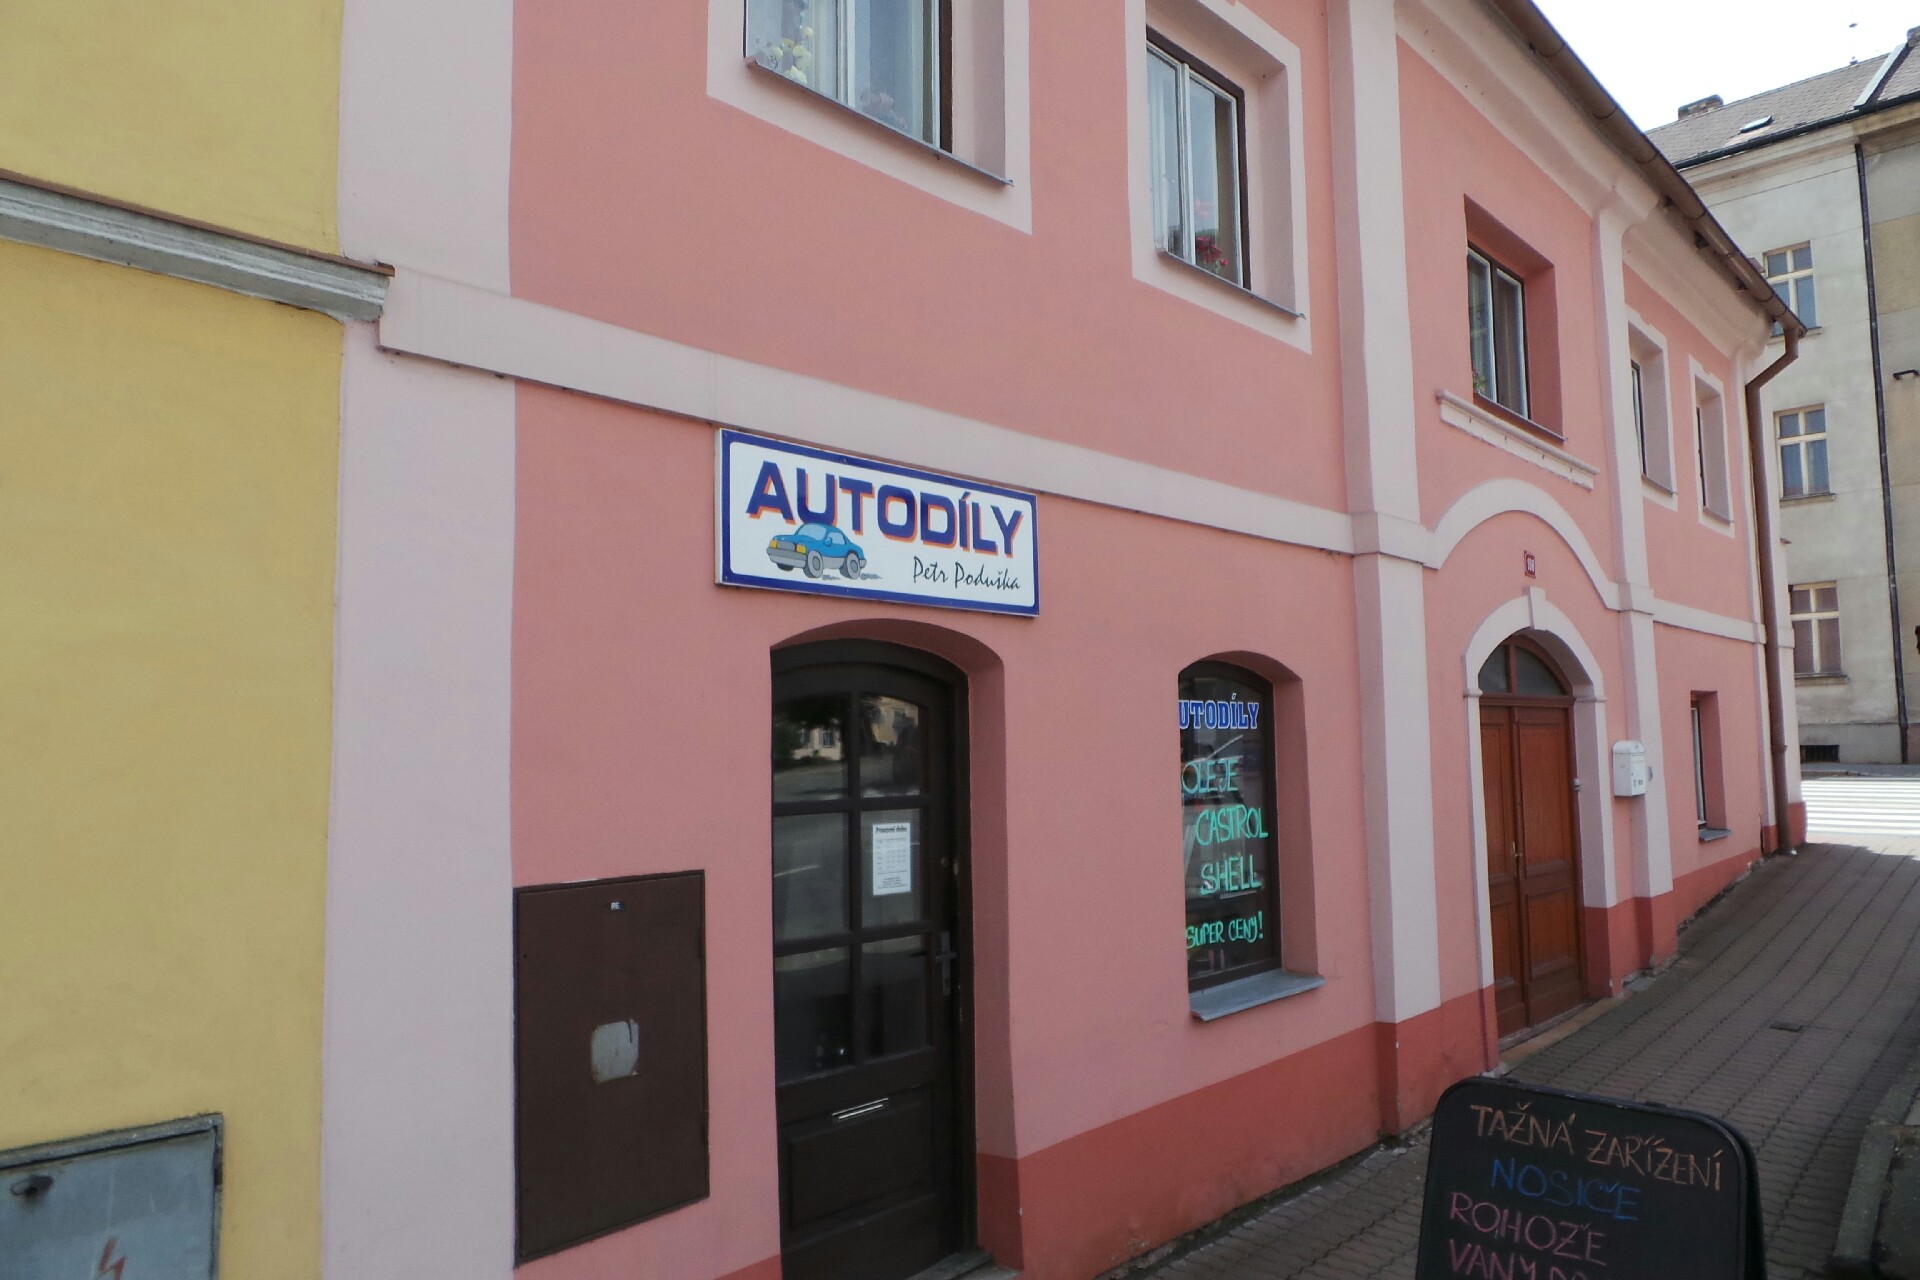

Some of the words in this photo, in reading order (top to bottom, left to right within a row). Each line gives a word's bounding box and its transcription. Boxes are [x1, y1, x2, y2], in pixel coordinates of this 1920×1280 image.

[746, 460, 1023, 558] AUTODÍLY
[912, 555, 949, 584] Petr
[954, 560, 1021, 590] Poduška
[1178, 692, 1260, 730] UTODÍLY
[1182, 758, 1239, 794] OLEJE
[1195, 804, 1268, 846] CASTROL
[1200, 855, 1262, 895] SHELL
[1185, 920, 1226, 950] SUPER
[1228, 910, 1264, 944] CENY!
[1470, 1102, 1576, 1155] TAŽNÁ
[1585, 1129, 1724, 1191] ZAŘÍZENÍ
[1450, 1191, 1608, 1266] ROHOŽE
